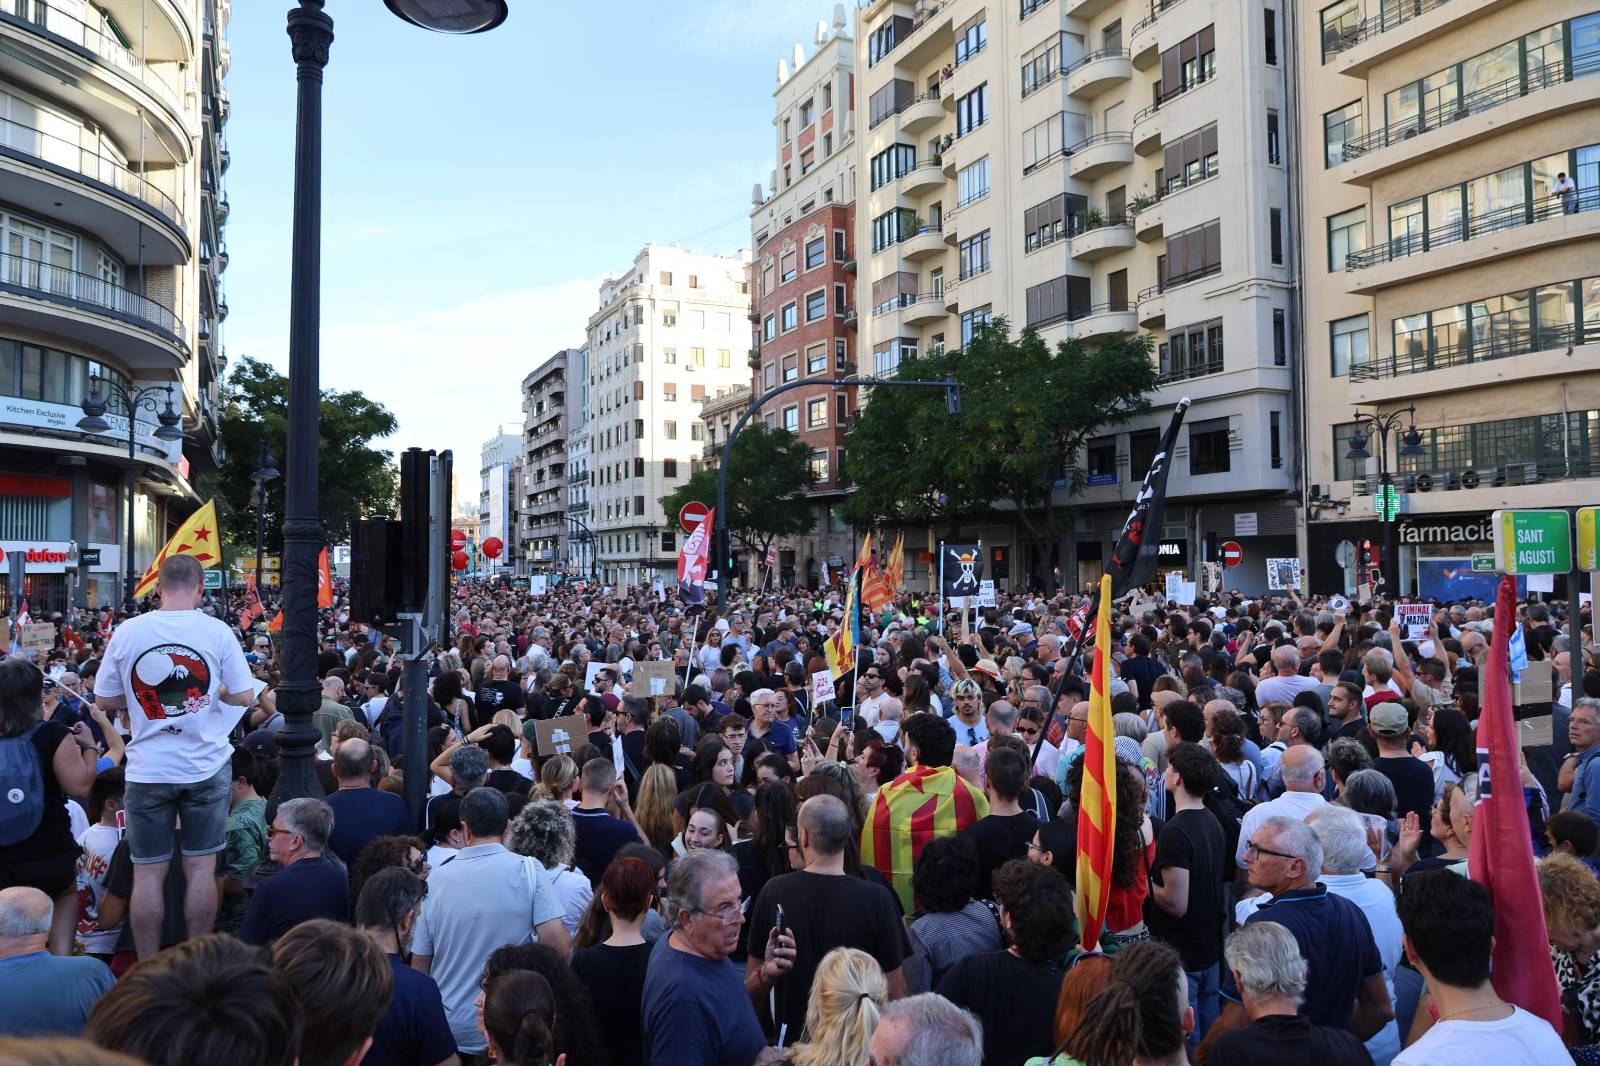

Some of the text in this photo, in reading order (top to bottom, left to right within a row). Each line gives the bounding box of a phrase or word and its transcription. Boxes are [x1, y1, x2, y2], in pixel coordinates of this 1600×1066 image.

[6, 405, 66, 419] Kitchen Exclusive
[1517, 529, 1544, 544] SANT
[1519, 546, 1555, 565] AGUSTÍ
[1397, 605, 1430, 615] CRIMINAL
